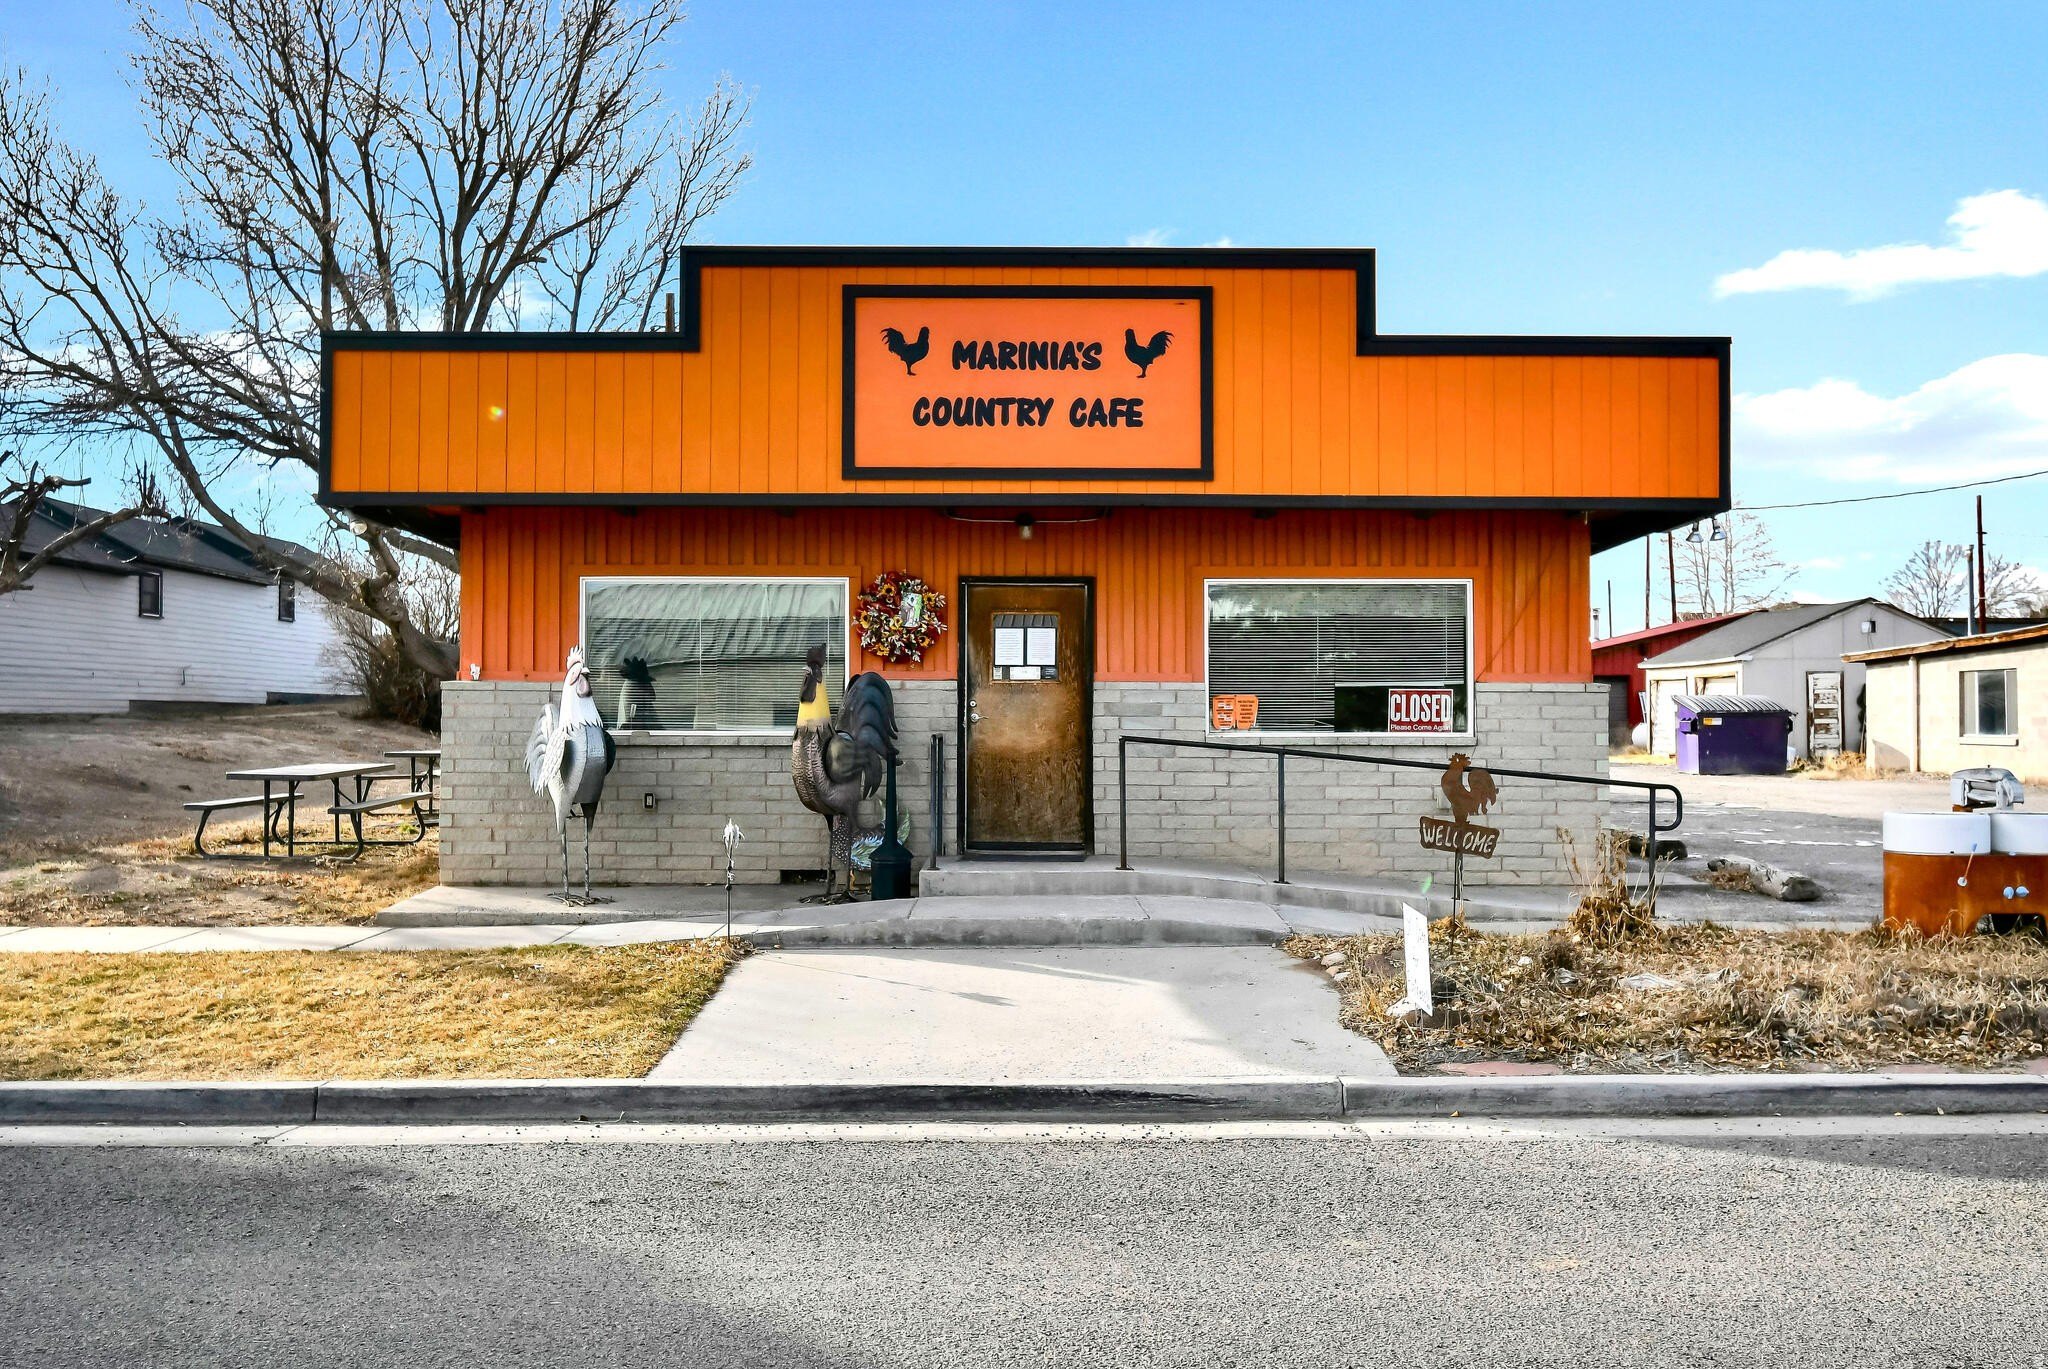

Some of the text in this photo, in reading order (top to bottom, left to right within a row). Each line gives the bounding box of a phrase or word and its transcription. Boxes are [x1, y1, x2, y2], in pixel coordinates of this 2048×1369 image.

[951, 340, 1103, 371] MARINIA'S
[912, 396, 1144, 428] COUNTRY CAFE
[1391, 694, 1451, 722] CLOSED
[1422, 823, 1496, 853] WELCOME
